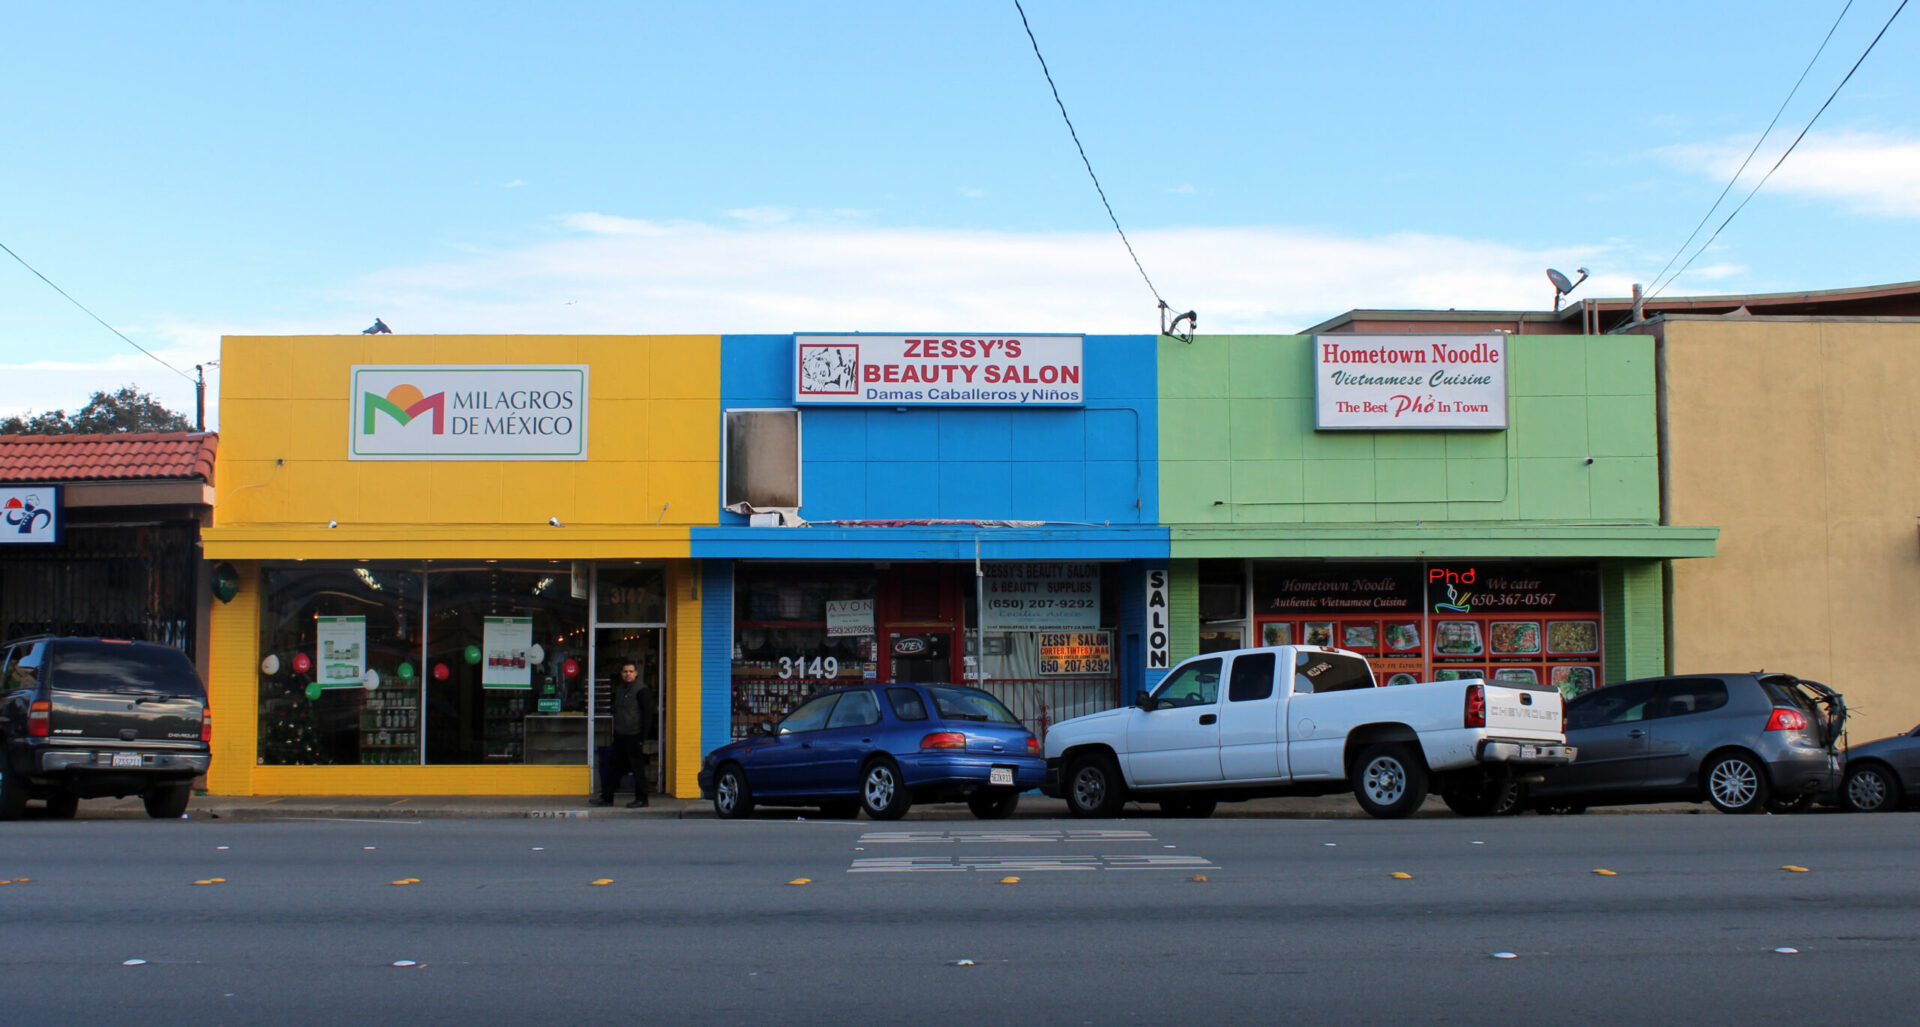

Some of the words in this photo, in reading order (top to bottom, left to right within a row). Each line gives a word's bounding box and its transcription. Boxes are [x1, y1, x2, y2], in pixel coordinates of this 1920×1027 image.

[903, 339, 1022, 358] ZESSY'S
[1322, 343, 1426, 364] Hometown
[1432, 343, 1499, 364] Noodle
[863, 365, 979, 383] BEAUTY
[984, 365, 1080, 384] SALON
[1331, 369, 1423, 386] Vietnamese
[1428, 369, 1492, 387] Cuisine
[452, 390, 573, 410] MILAGROS
[866, 388, 923, 400] Damas
[928, 388, 1017, 400] Caballeros
[1020, 391, 1030, 403] y
[1032, 388, 1080, 401] Niños
[1336, 401, 1360, 413] The
[1363, 401, 1388, 413] Best
[1438, 401, 1450, 413] In
[1453, 401, 1489, 413] Town
[452, 416, 479, 435] DE
[484, 412, 573, 435] MÉXICO
[1026, 563, 1064, 578] BEAUTY
[1067, 563, 1098, 578] SALON
[991, 582, 998, 593] &
[1001, 582, 1038, 593] BEAUTY
[1047, 582, 1092, 593] SUPPLIES
[1282, 578, 1349, 592] Hometown
[1351, 577, 1396, 592] Noodle
[1486, 577, 1508, 589] We
[1510, 579, 1542, 590] cater
[828, 600, 873, 613] AVON
[988, 599, 1024, 610] (650)
[1029, 599, 1094, 609] 207-9292
[1271, 596, 1317, 608] Authentic
[1319, 596, 1372, 607] Vietnamese
[1373, 596, 1408, 608] Cuisine
[1471, 593, 1557, 606] 650-367-0567
[1149, 571, 1166, 667] SALON
[895, 641, 923, 651] OPEN
[1041, 633, 1071, 646] ZESSY
[1078, 632, 1109, 646] SALON
[778, 656, 838, 679] 3149
[1041, 660, 1059, 673] 650
[1064, 659, 1110, 673] 207-9292
[1490, 706, 1559, 721] CHEVROLET
